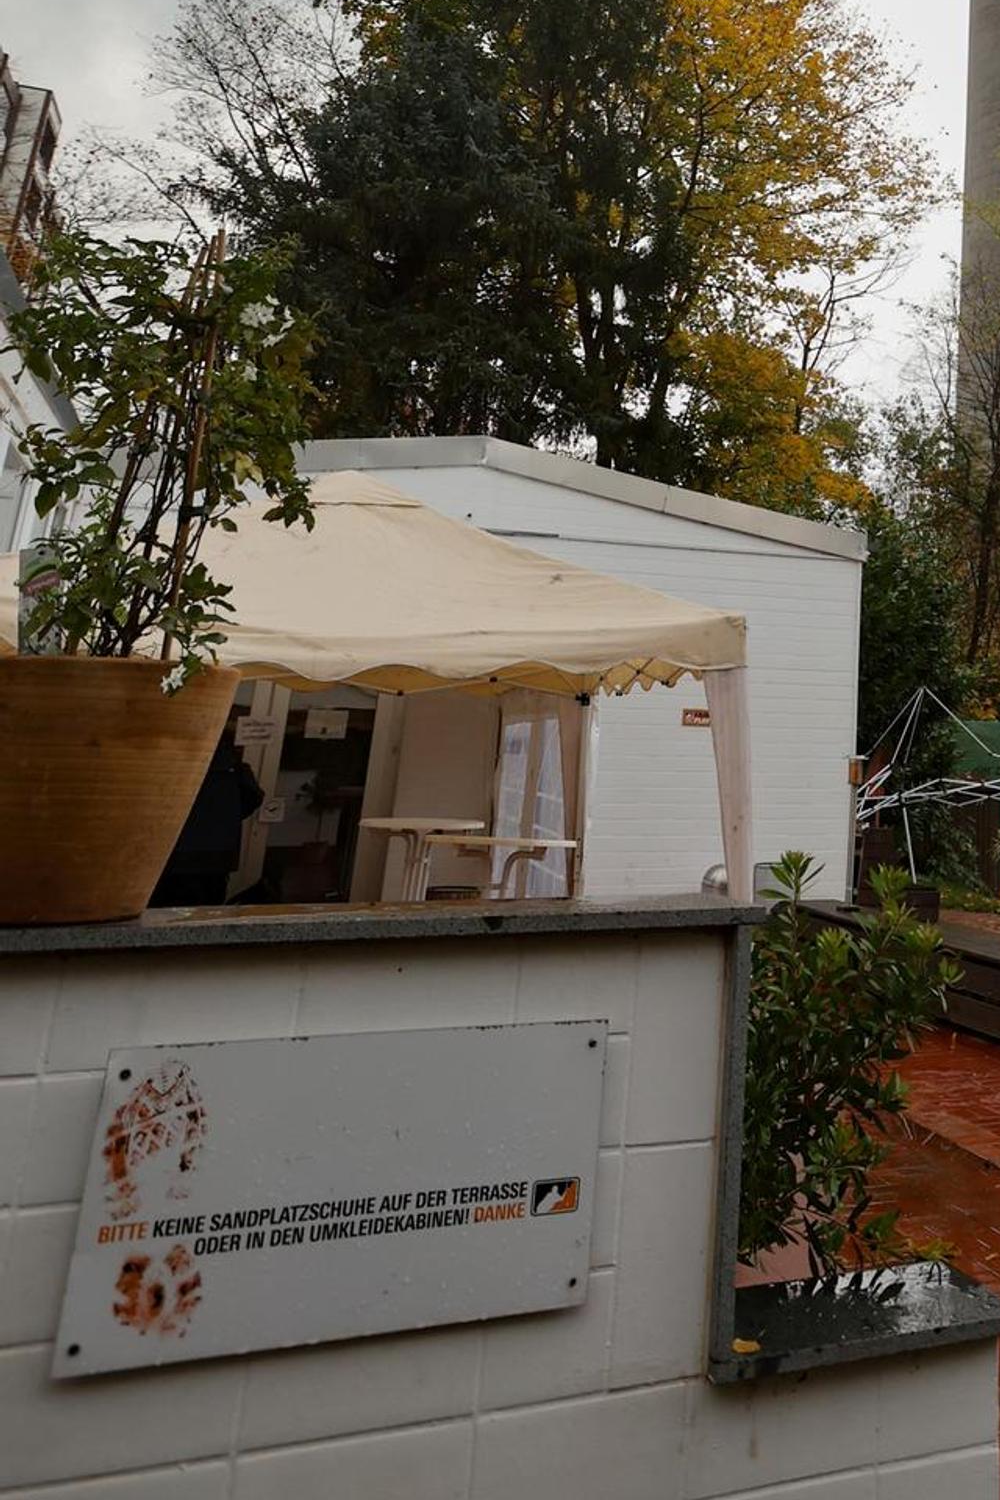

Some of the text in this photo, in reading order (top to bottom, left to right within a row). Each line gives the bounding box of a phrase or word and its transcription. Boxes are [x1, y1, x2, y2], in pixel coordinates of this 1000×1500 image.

[97, 1181, 528, 1244] BITTE KEINE SANDPLATZSCHUHE AUF DER TERRASSE
[194, 1202, 526, 1256] ODER IN DEN UMKLEIDEKABINEN! DANKE
